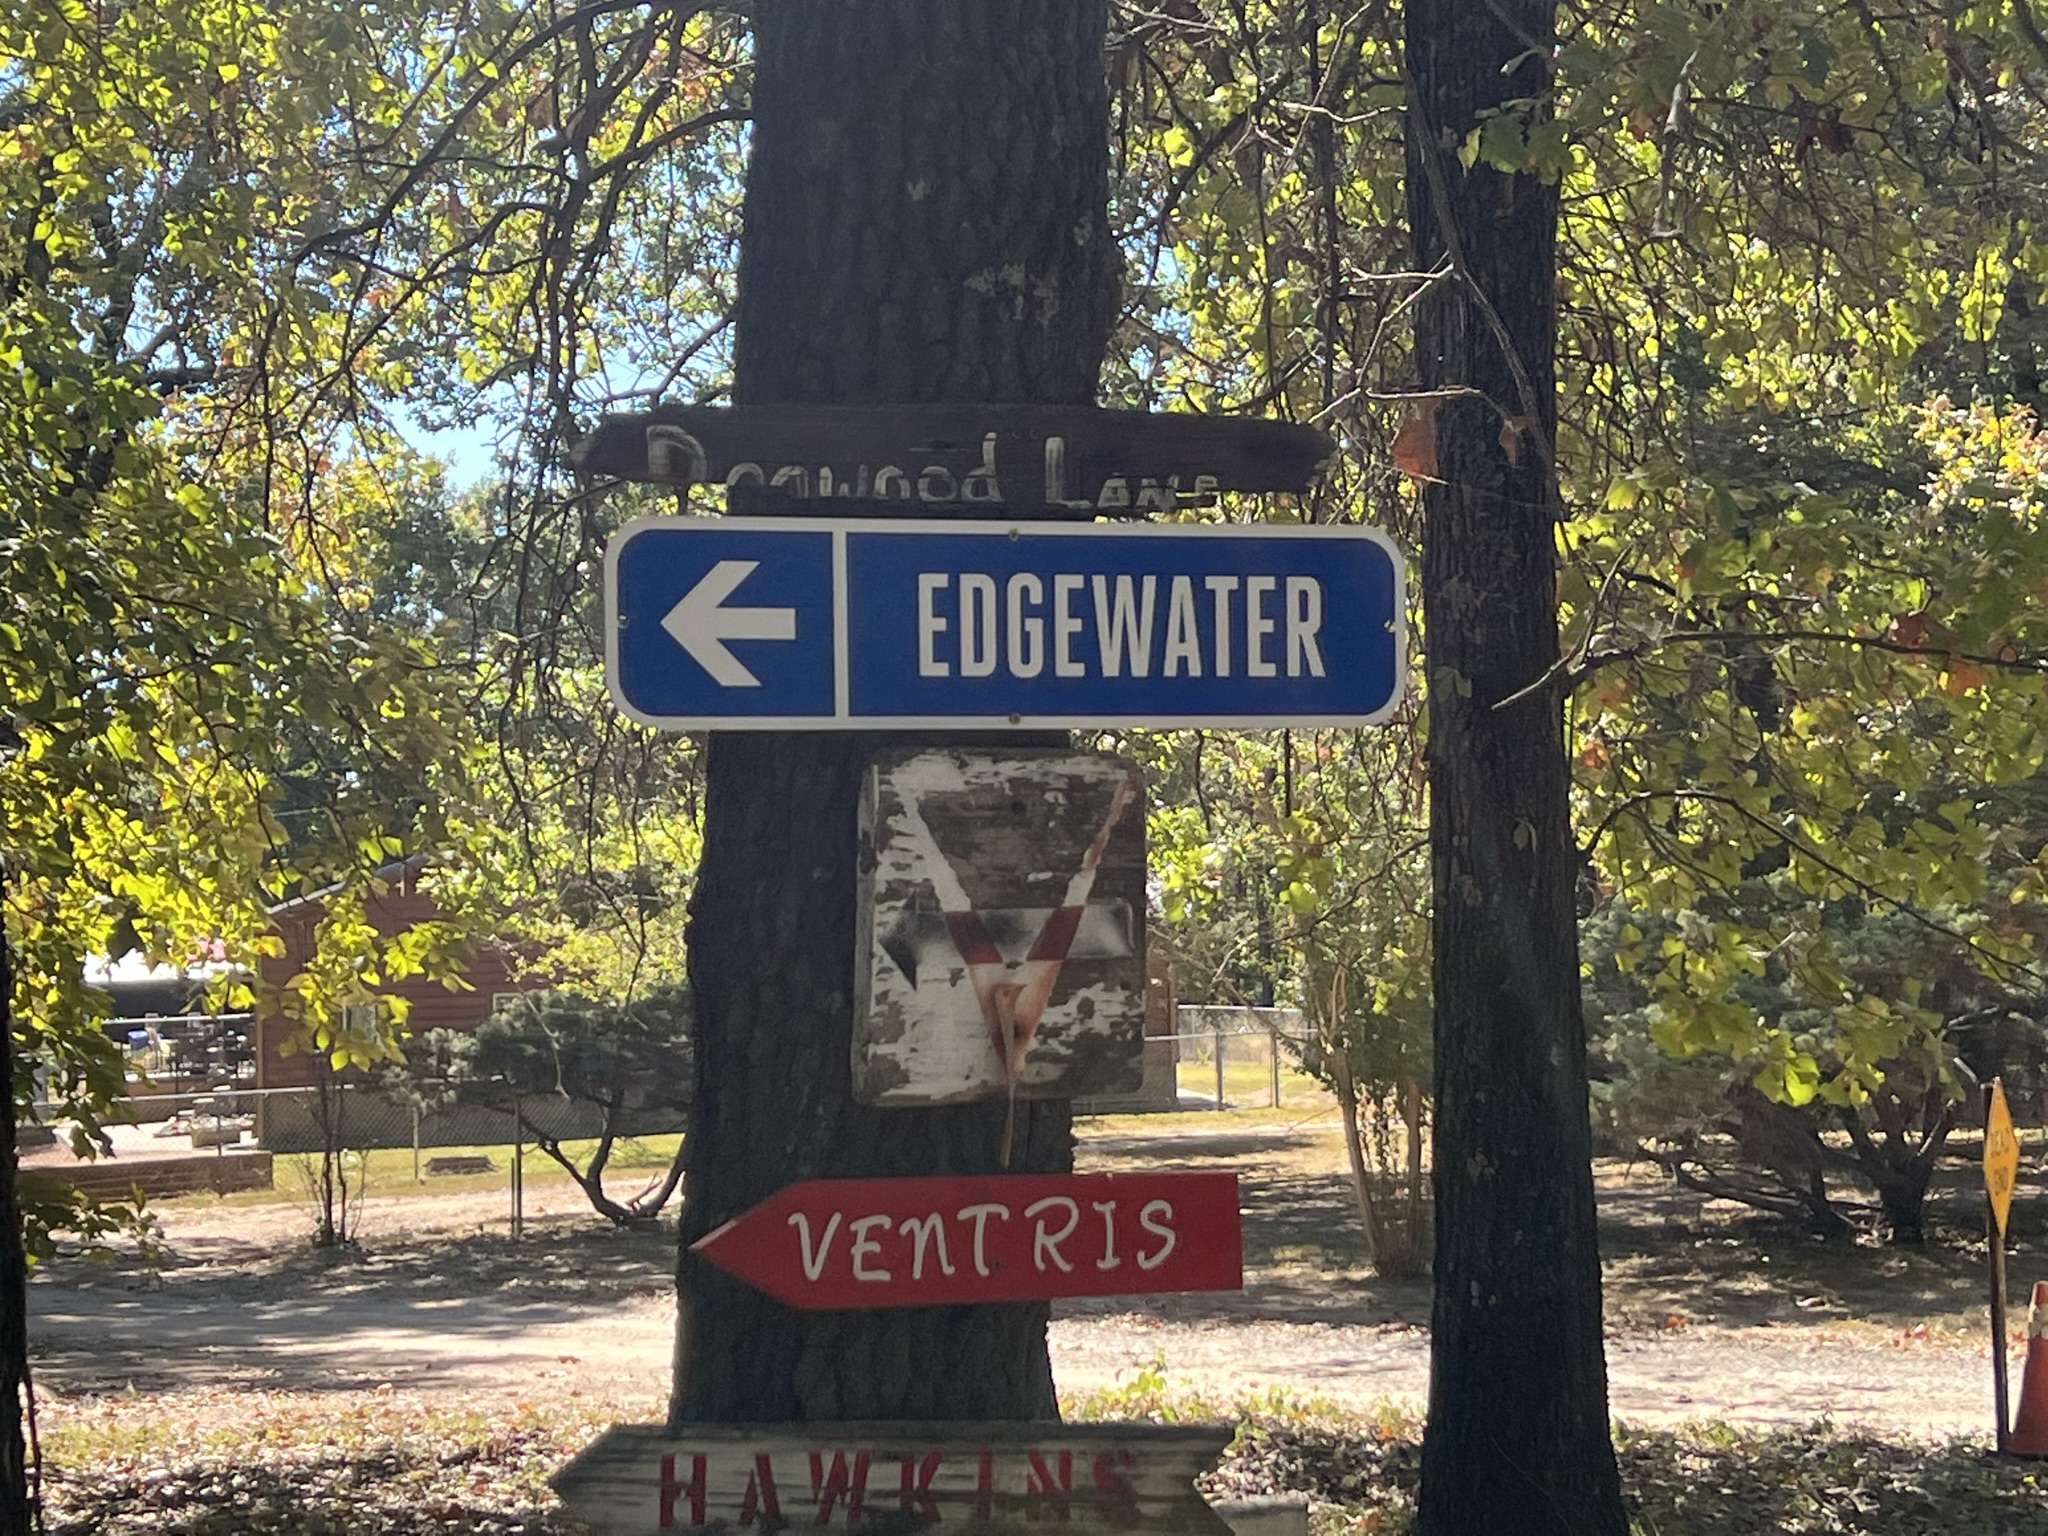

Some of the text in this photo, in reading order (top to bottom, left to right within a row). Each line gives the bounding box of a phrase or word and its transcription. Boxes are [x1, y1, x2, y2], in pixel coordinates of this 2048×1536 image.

[917, 572, 1326, 679] EDGEWATER
[788, 1196, 1178, 1282] VENTRIS
[659, 1447, 1137, 1528] HAWKINS
